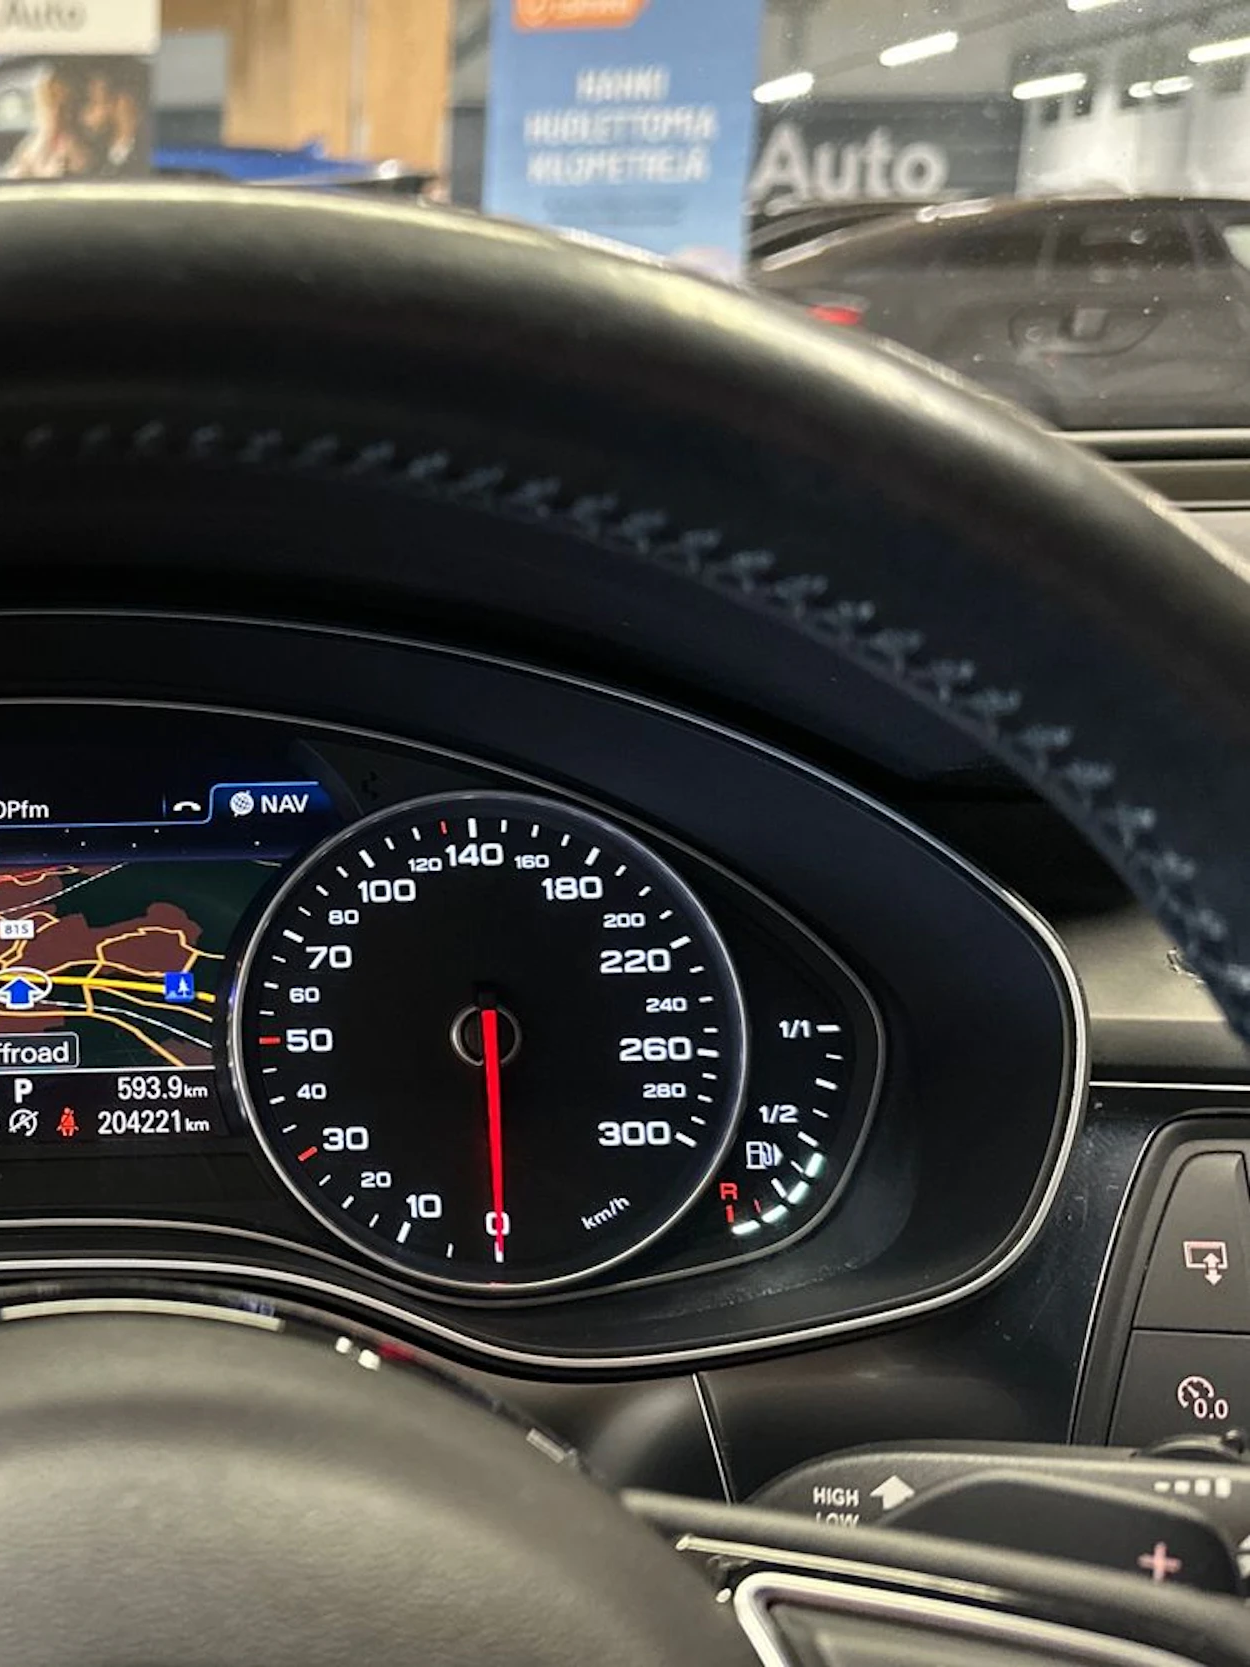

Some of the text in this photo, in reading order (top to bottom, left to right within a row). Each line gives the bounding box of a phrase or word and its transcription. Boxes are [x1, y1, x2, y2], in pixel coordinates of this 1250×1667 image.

[751, 121, 948, 203] Auto
[260, 793, 310, 814] NAV
[407, 857, 443, 872] 120
[445, 842, 504, 867] 140
[514, 854, 550, 869] 160
[357, 878, 416, 903] 100
[541, 876, 603, 901] 180
[328, 909, 360, 925] 80
[603, 912, 646, 929] 200
[305, 945, 352, 970] 70
[600, 948, 671, 974] 220
[289, 986, 320, 1003] 60
[645, 997, 687, 1013] 240
[286, 1027, 333, 1053] 50
[778, 1019, 810, 1039] 1/1
[619, 1036, 692, 1062] 260
[14, 1078, 33, 1104] P
[296, 1083, 327, 1100] 40
[642, 1082, 687, 1099] 280
[758, 1104, 798, 1124] 1/2
[322, 1126, 369, 1151] 30
[597, 1121, 671, 1147] 300
[360, 1171, 392, 1188] 20
[720, 1182, 738, 1200] R
[405, 1194, 442, 1219] 10
[581, 1197, 630, 1230] km/h
[1193, 1396, 1229, 1420] 0.0
[813, 1486, 859, 1507] HIGH
